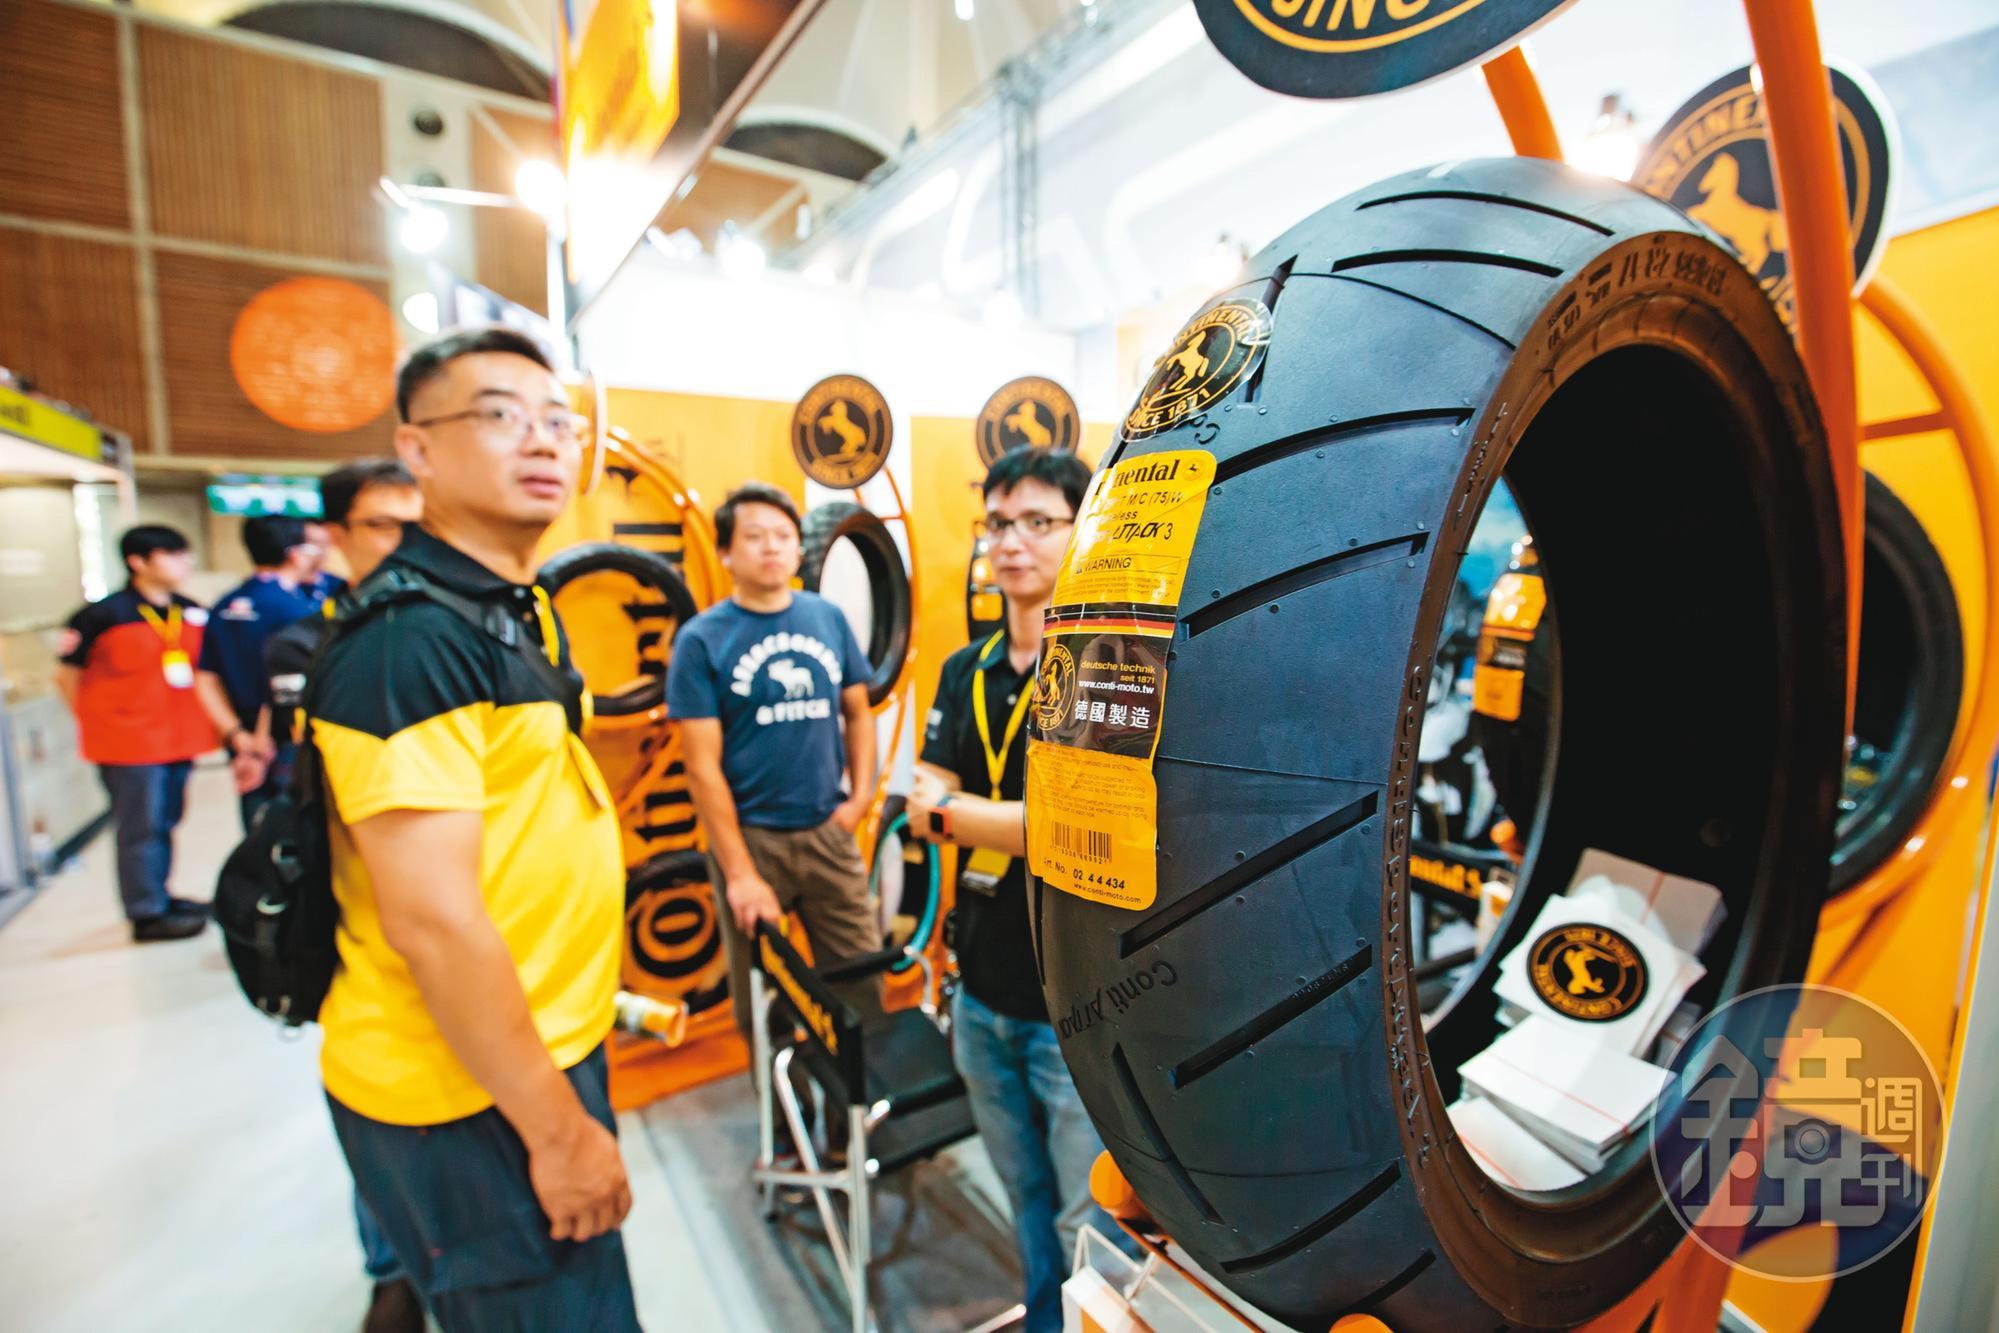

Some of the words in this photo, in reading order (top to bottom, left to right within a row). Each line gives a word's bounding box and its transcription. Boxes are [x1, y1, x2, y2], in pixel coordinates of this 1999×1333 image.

[1081, 661, 1118, 671] deutsche
[1120, 663, 1156, 675] technik
[1078, 680, 1155, 695] www.conti-moto.tw
[1074, 699, 1151, 729] 德國製造
[1072, 868, 1083, 881] 02
